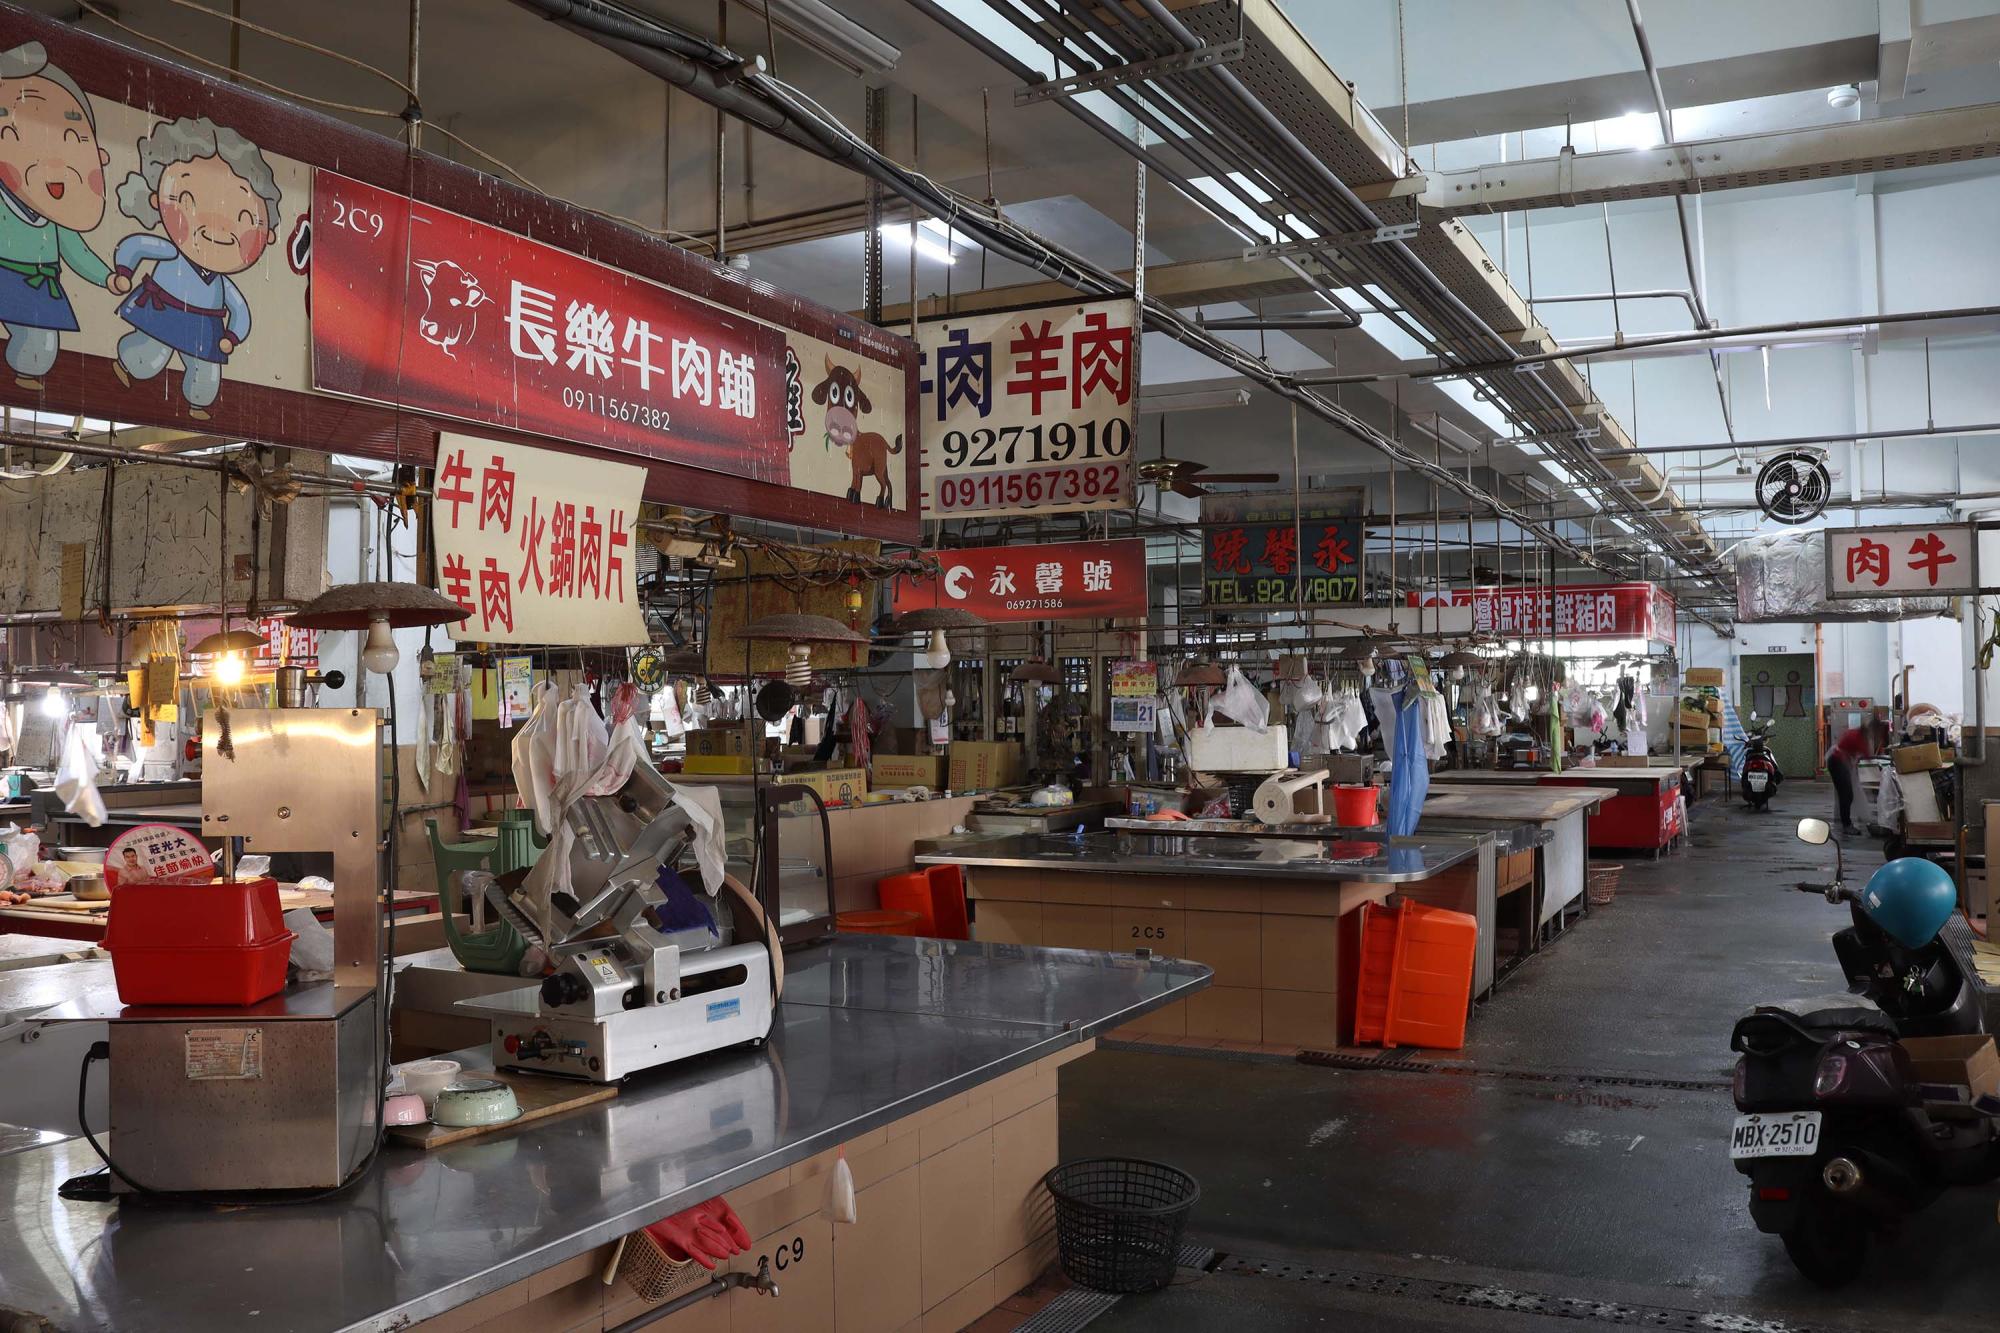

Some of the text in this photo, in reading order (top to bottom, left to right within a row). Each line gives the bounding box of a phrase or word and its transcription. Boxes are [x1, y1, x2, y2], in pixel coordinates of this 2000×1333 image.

[331, 199, 384, 238] 2C9
[504, 279, 756, 419] 長樂牛肉鋪
[1007, 312, 1133, 416] 羊肉
[562, 386, 671, 431] 0911567382
[942, 417, 1131, 469] 9271910
[438, 449, 515, 534] 牛肉
[940, 465, 1120, 508] 0911567382
[518, 496, 628, 603] 火鍋肉片
[442, 553, 514, 634] 羊肉
[989, 559, 1113, 596] 永馨號
[1006, 598, 1063, 610] 069271586
[1139, 705, 1153, 722] 21
[148, 837, 187, 855] 莊光大
[153, 855, 205, 877] 佳節愉快
[1131, 926, 1165, 939] 2C5
